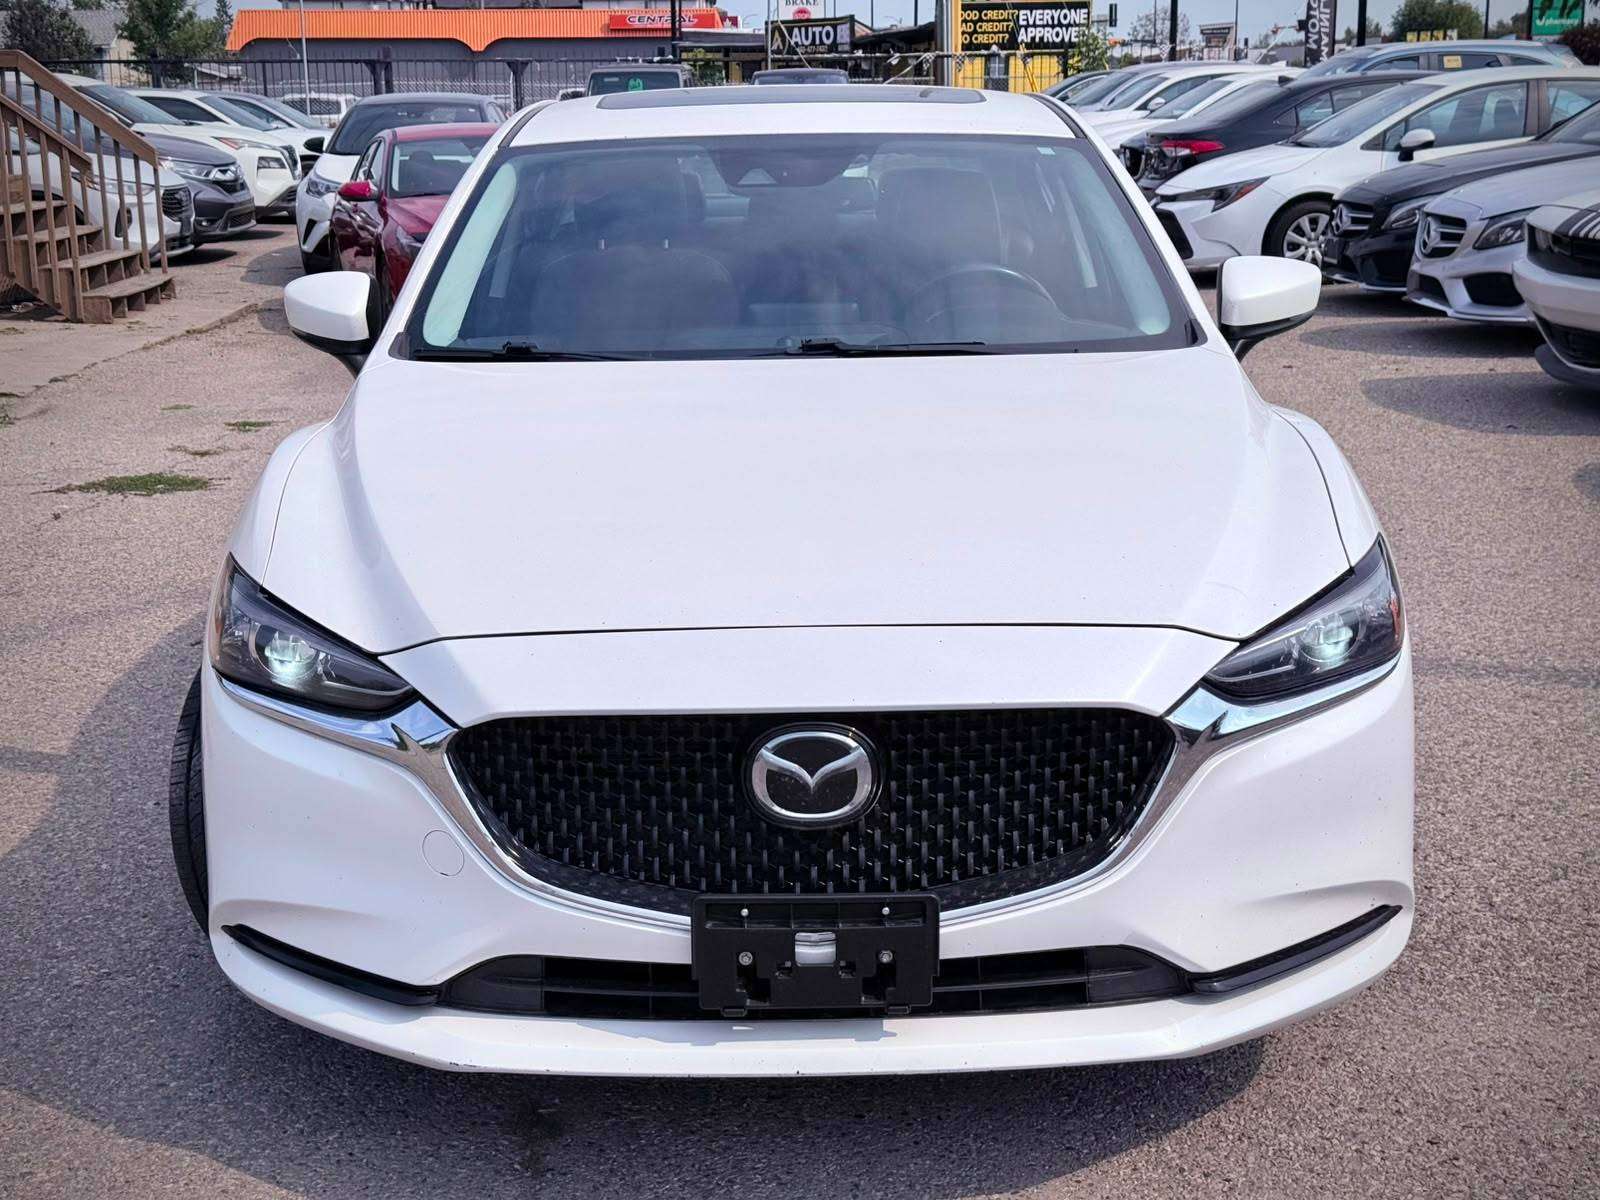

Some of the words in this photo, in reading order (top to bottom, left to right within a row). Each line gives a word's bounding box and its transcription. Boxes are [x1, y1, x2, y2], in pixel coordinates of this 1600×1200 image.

[960, 10, 979, 20] OOD
[981, 9, 1018, 20] CREDIT?
[1019, 8, 1088, 25] EVERYONE
[960, 22, 974, 32] AD
[976, 22, 1014, 32] CREDIT?
[792, 26, 834, 46] AUTO
[960, 34, 970, 43] O
[972, 33, 1009, 43] CREDIT?
